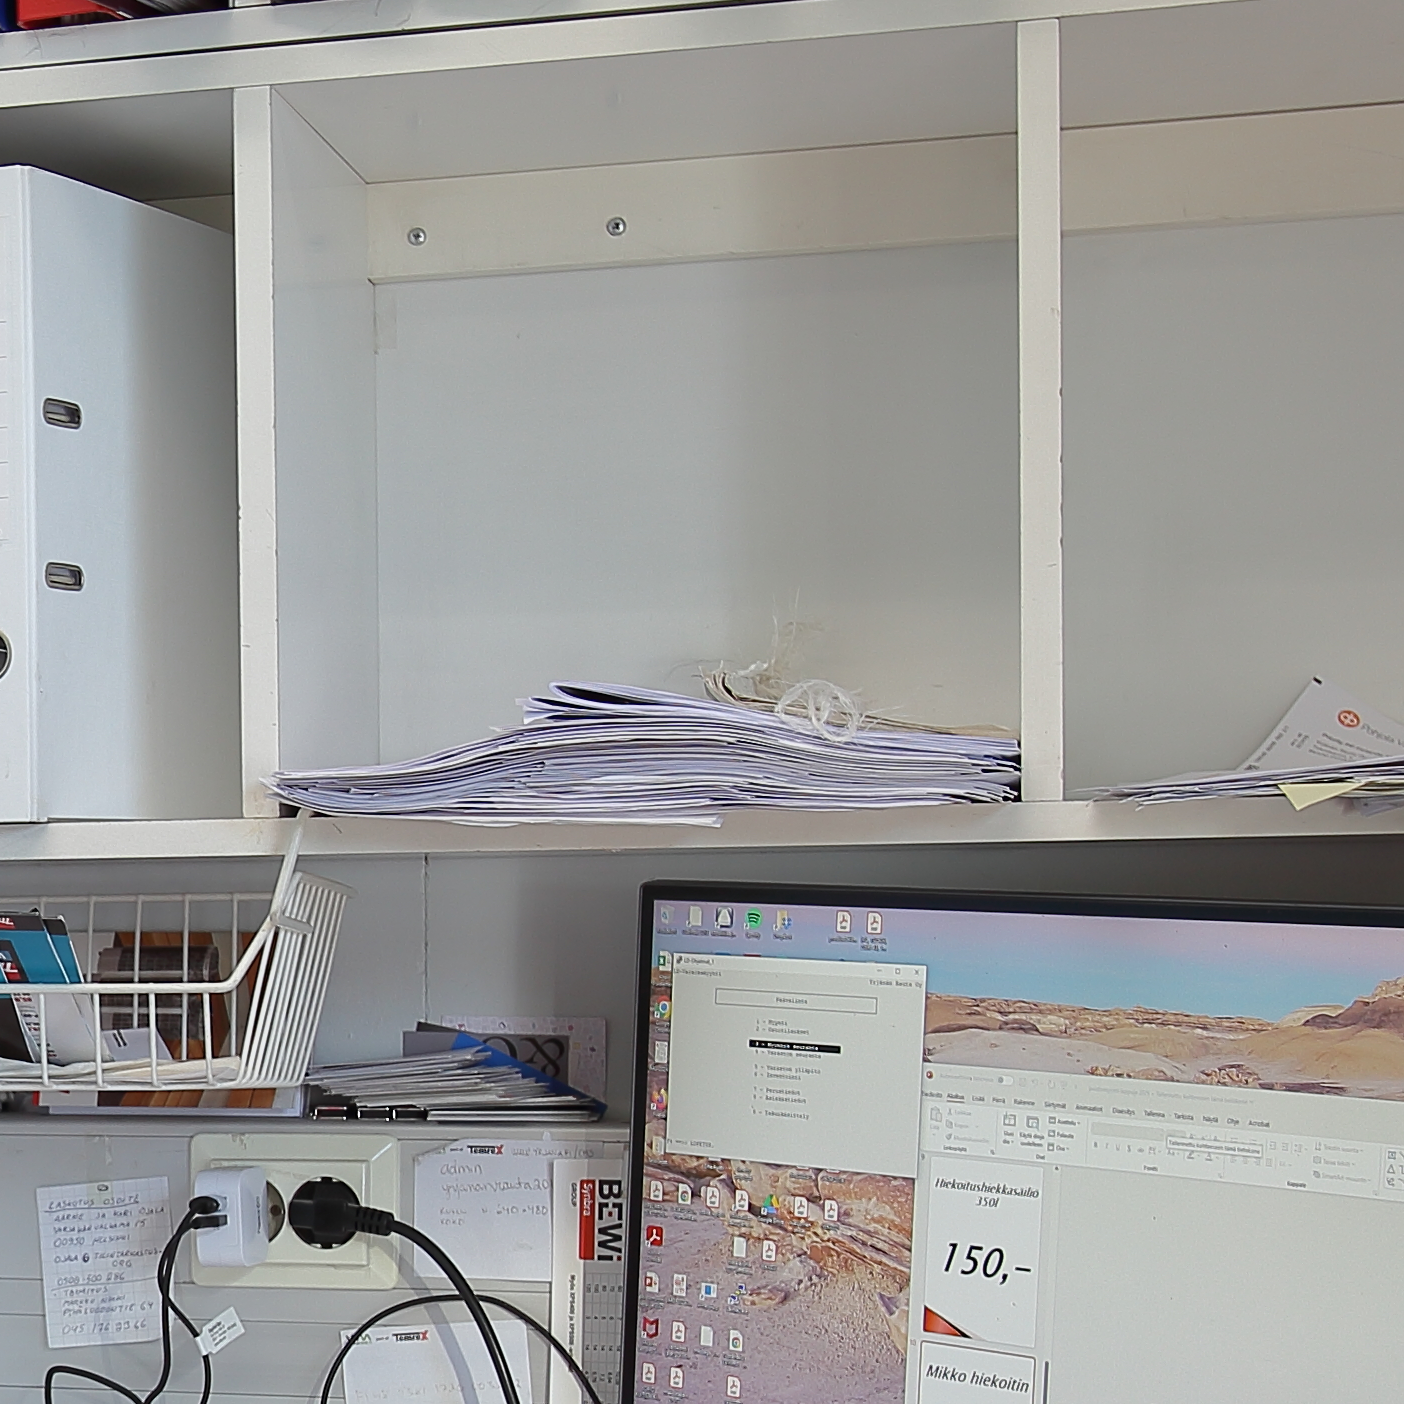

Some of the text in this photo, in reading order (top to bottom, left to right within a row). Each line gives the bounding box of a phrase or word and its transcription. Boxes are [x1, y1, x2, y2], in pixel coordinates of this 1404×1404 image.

[440, 1160, 483, 1176] admin
[570, 1182, 578, 1207] GROUP
[581, 1183, 593, 1217] Synbra
[597, 1179, 623, 1262] BEWi
[940, 1240, 1032, 1285] 150,-
[925, 1363, 1030, 1395] Mikko hiekoitin
